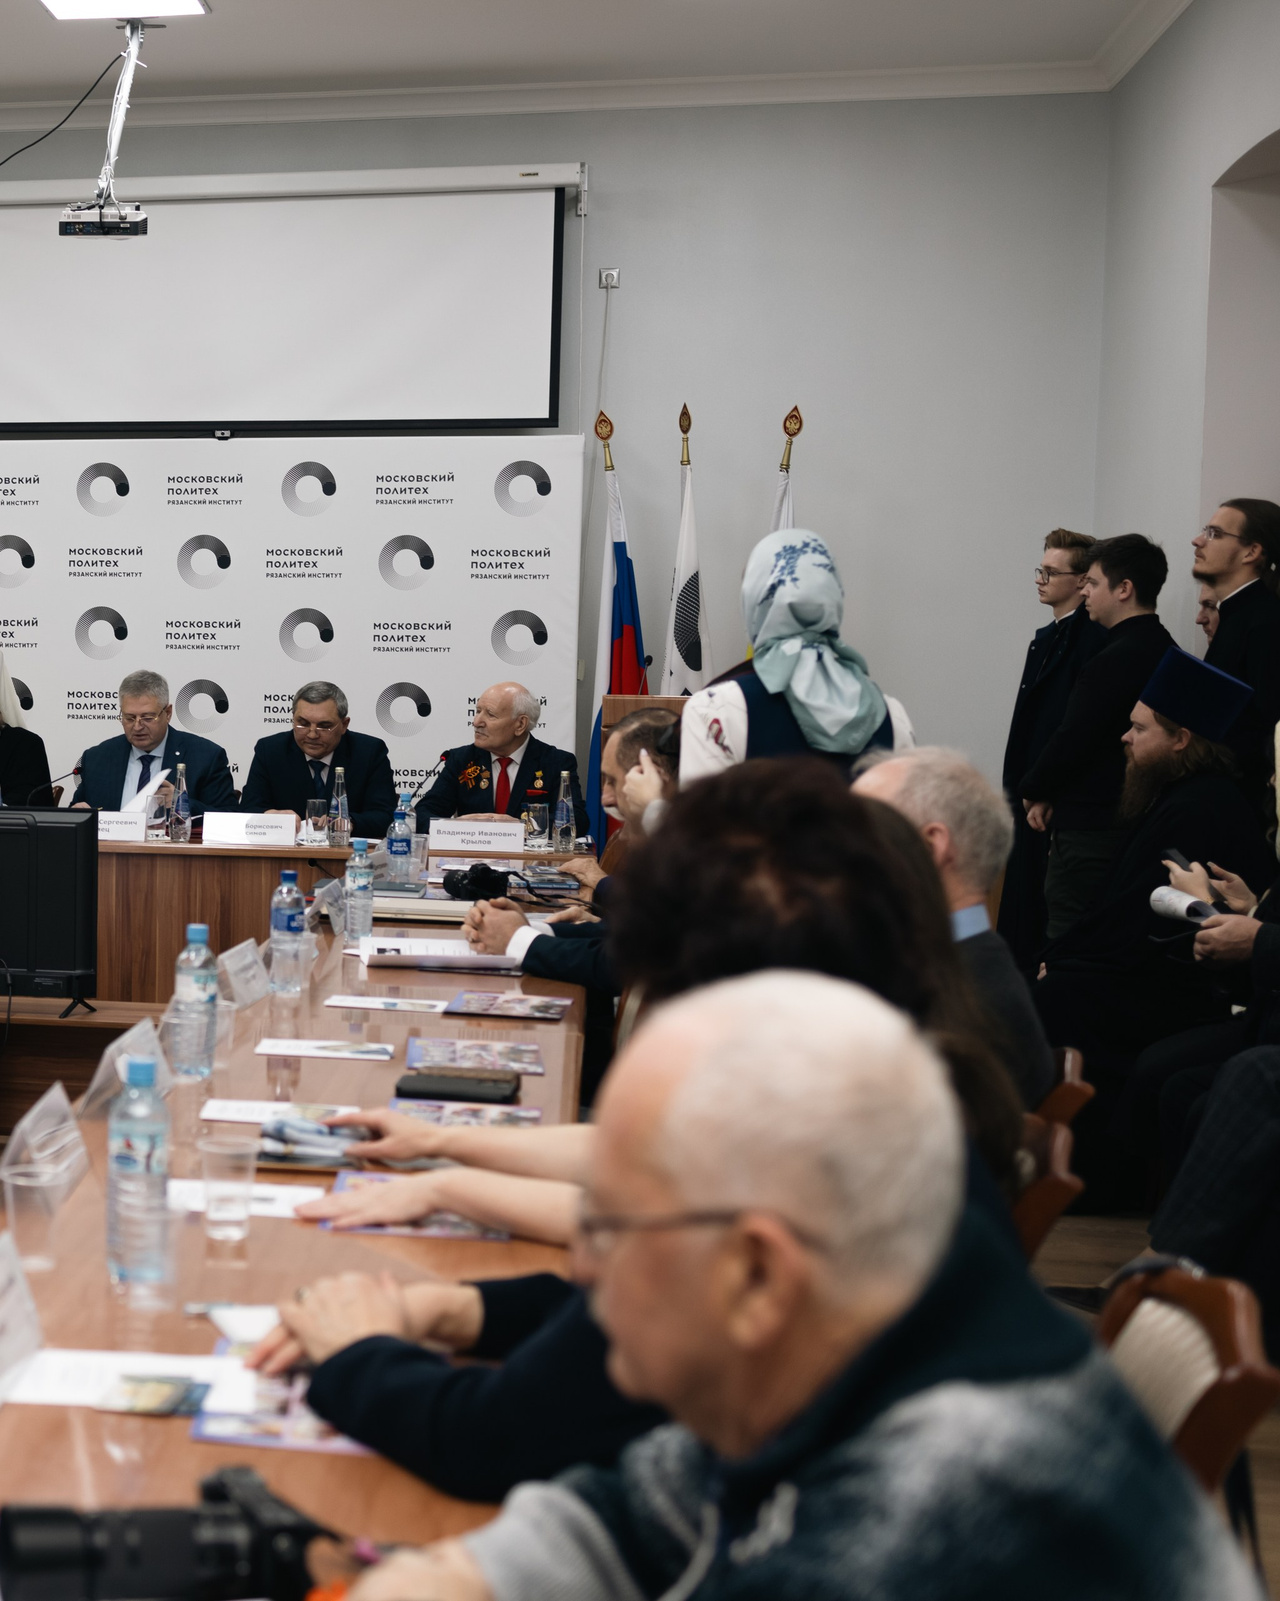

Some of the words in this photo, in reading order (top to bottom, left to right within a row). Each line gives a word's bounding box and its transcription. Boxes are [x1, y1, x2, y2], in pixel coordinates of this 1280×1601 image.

[166, 498, 207, 506] РЯЗАНСКИЙ
[375, 497, 417, 506] РЯЗАНСКИЙ
[417, 498, 454, 506] ИНСТИТУТ
[68, 570, 108, 578] РЯЗАНСКИЙ
[265, 571, 307, 579] РЯЗАНСКИЙ
[470, 572, 513, 580] РЯЗАНСКИЙ
[165, 643, 205, 651] РЯЗАНСКИЙ
[372, 645, 414, 653] РЯЗАНСКИЙ
[66, 690, 119, 699] московс
[66, 713, 106, 721] РЯЗАНСКИЙ
[99, 818, 138, 827] Сергеевич
[436, 828, 477, 837] Владимир
[478, 829, 518, 838] Иванович
[460, 837, 493, 846] Крылов
